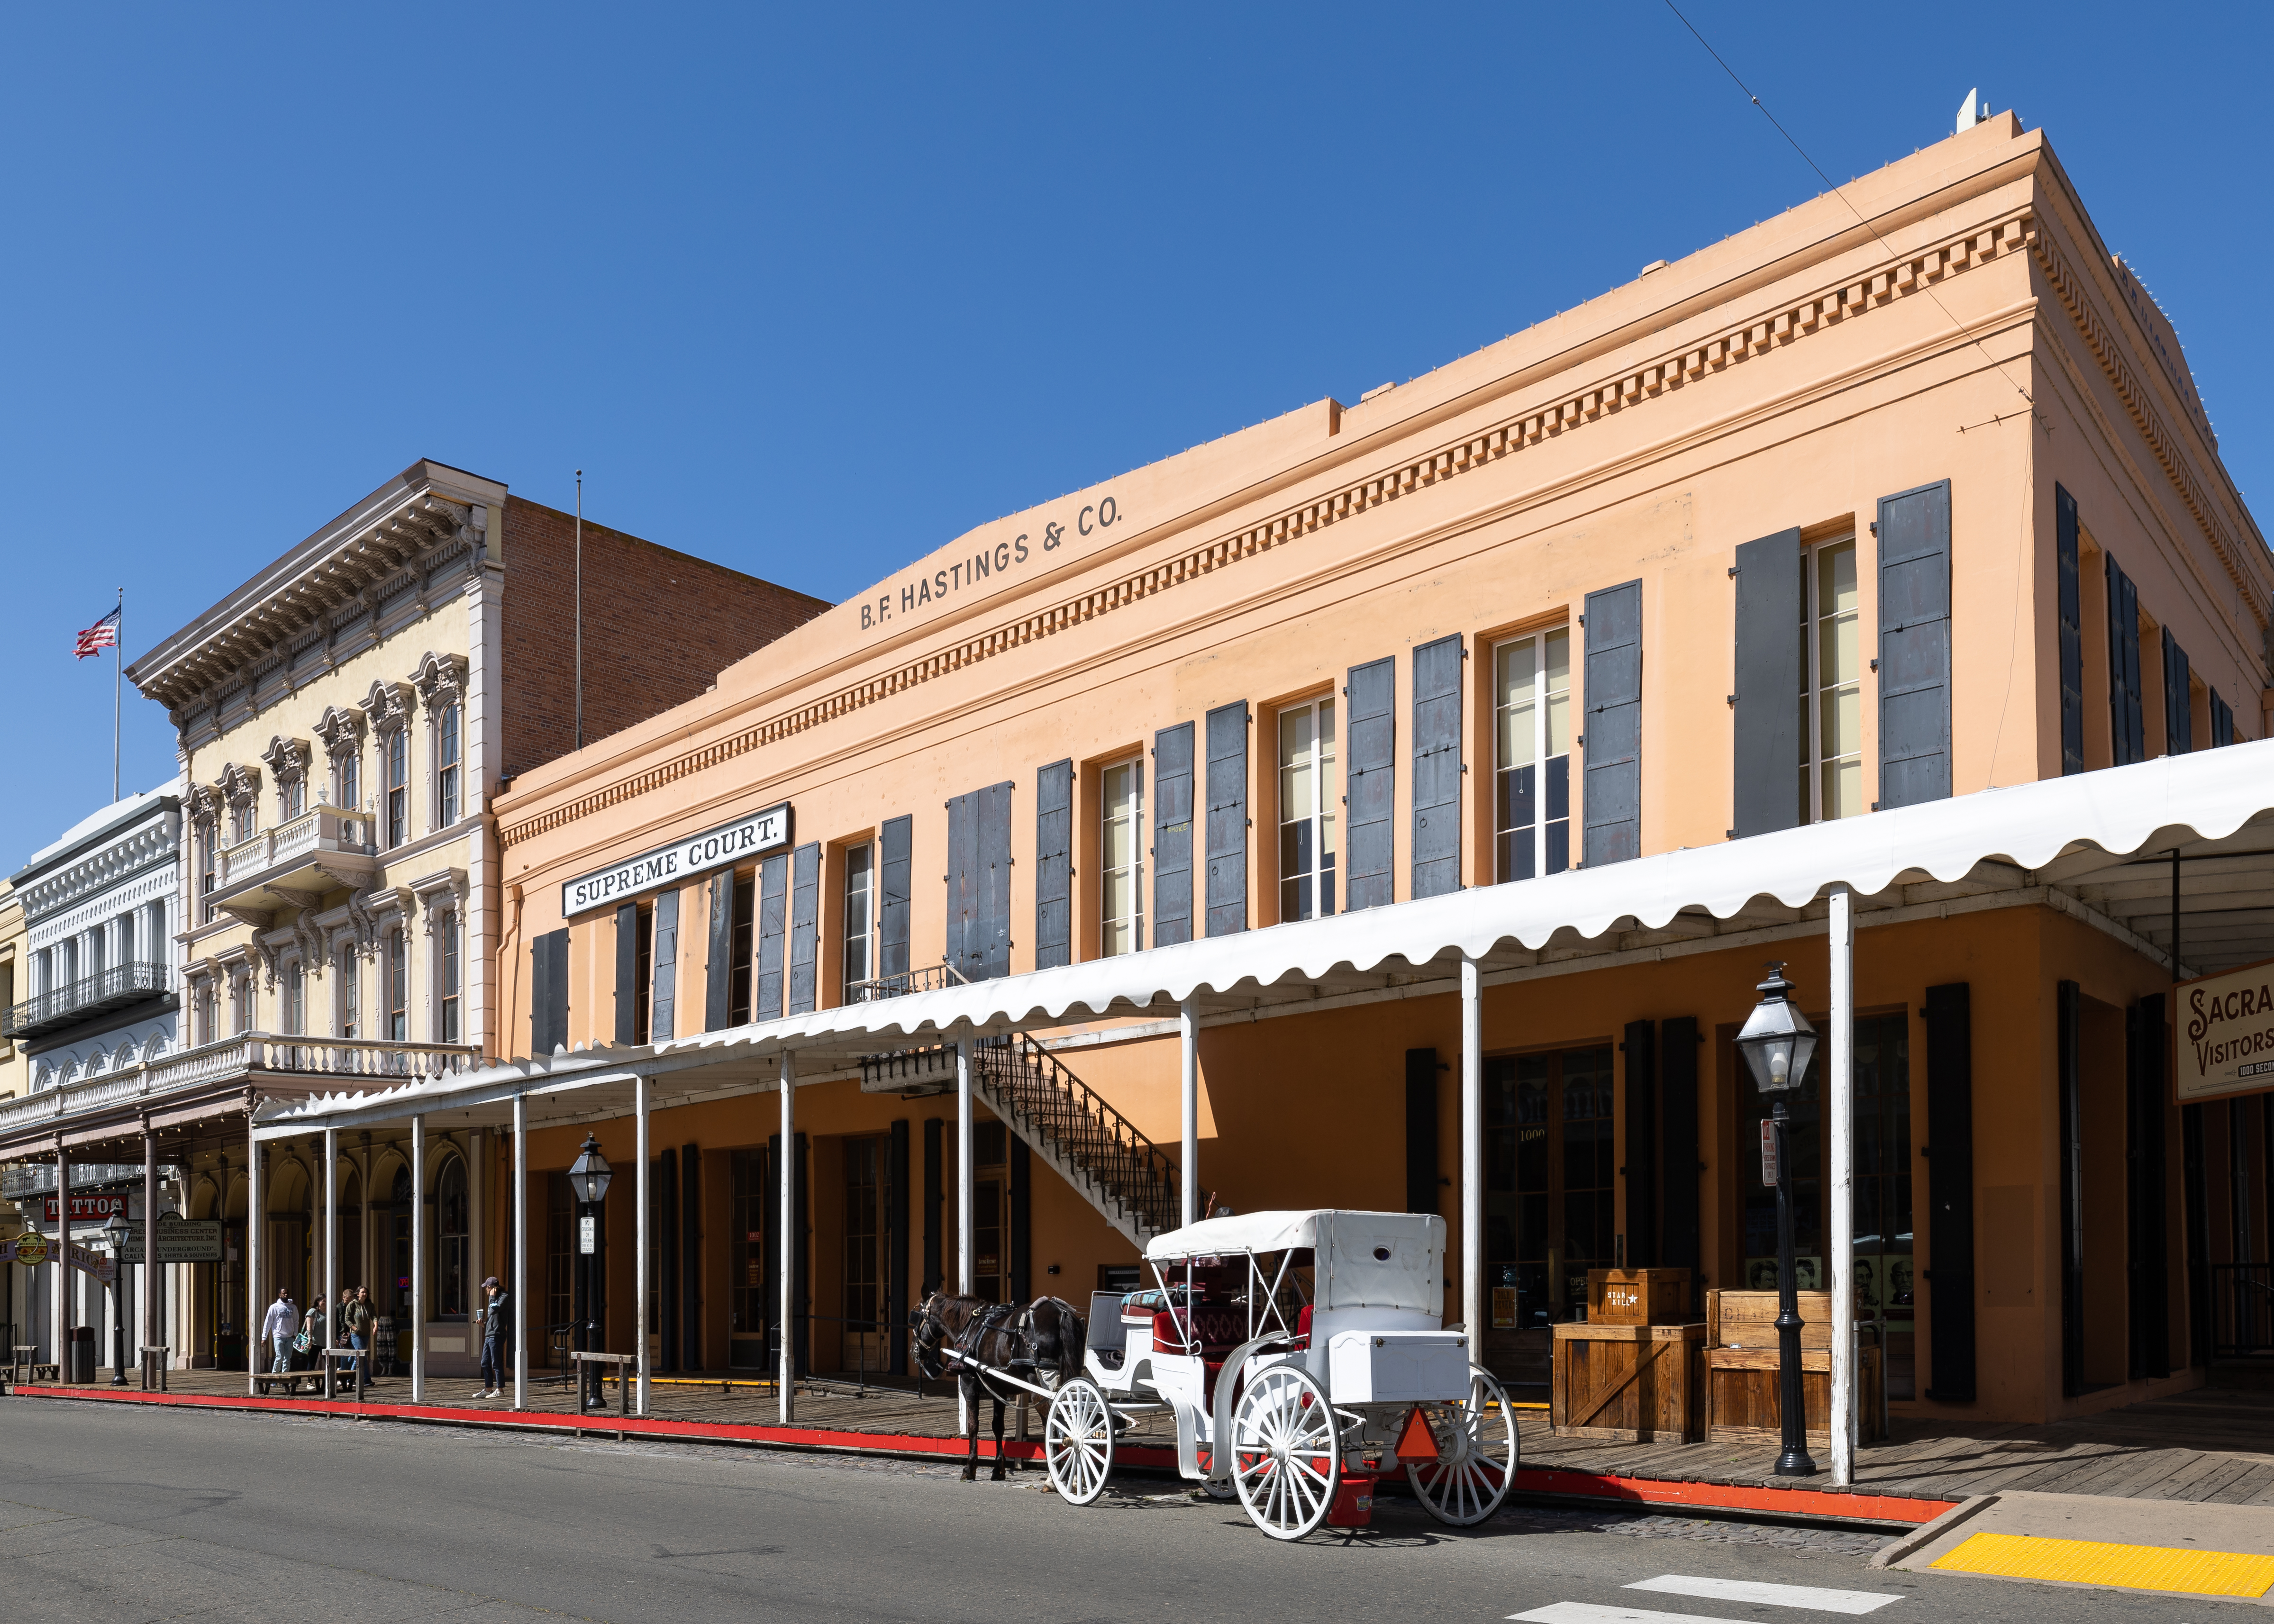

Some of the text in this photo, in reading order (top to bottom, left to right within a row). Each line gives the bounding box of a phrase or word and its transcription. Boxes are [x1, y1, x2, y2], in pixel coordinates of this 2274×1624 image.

[861, 496, 1122, 630] B.F. HASTINGS & CO.
[576, 817, 777, 906] SUPREME COURT.
[2195, 1027, 2274, 1077] VISITORS
[2240, 1065, 2254, 1076] 1000
[1520, 1129, 1545, 1141] 1000
[1763, 1125, 1769, 1137] NO
[1764, 1143, 1775, 1152] PARKING
[48, 1199, 122, 1215] TTTOO
[1498, 1291, 1510, 1299] GOLD
